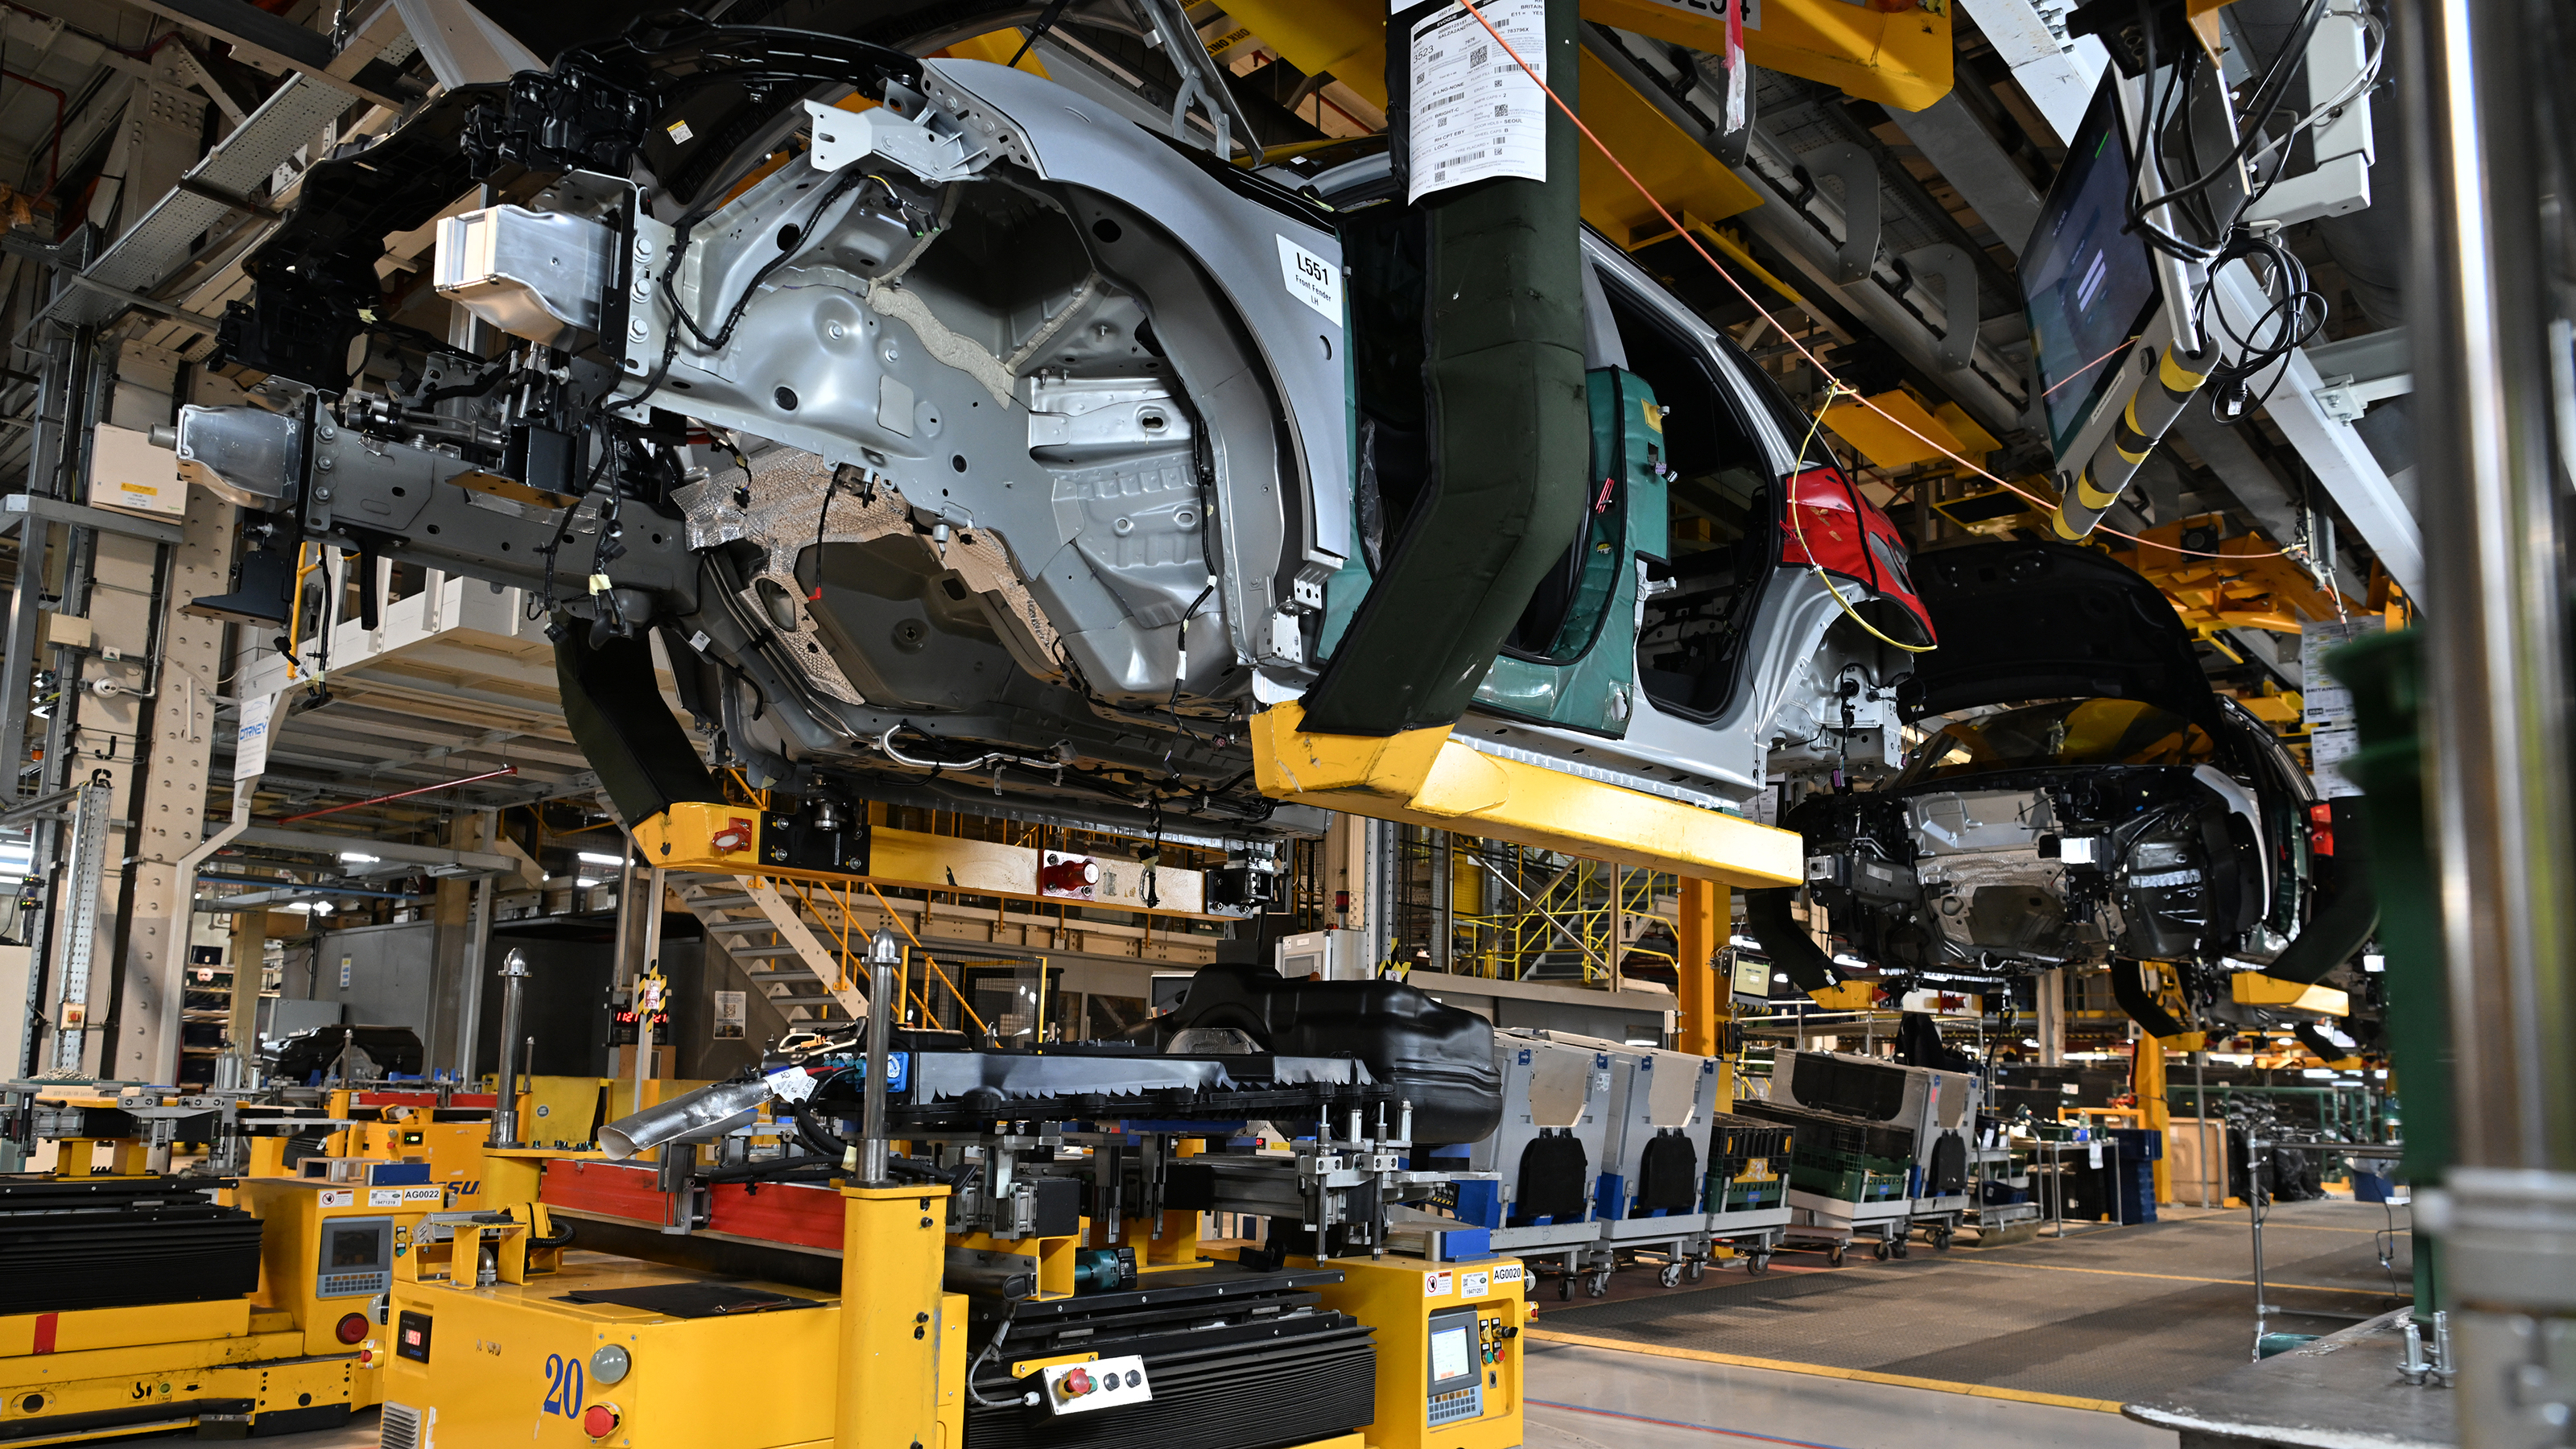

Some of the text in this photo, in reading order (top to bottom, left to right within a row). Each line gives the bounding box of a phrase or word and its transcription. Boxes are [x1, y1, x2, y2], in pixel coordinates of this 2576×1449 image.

[1437, 14, 1457, 27] EVOQUE
[1413, 45, 1434, 64] 3523
[1435, 107, 1459, 118] BRIGHT-C
[1434, 142, 1449, 151] LOCK
[1296, 252, 1329, 285] L551
[1296, 275, 1331, 302] Front Fender
[1311, 295, 1319, 306] LH
[95, 736, 116, 760] J
[1494, 1268, 1521, 1280] AG0020
[544, 1353, 583, 1419] 20
